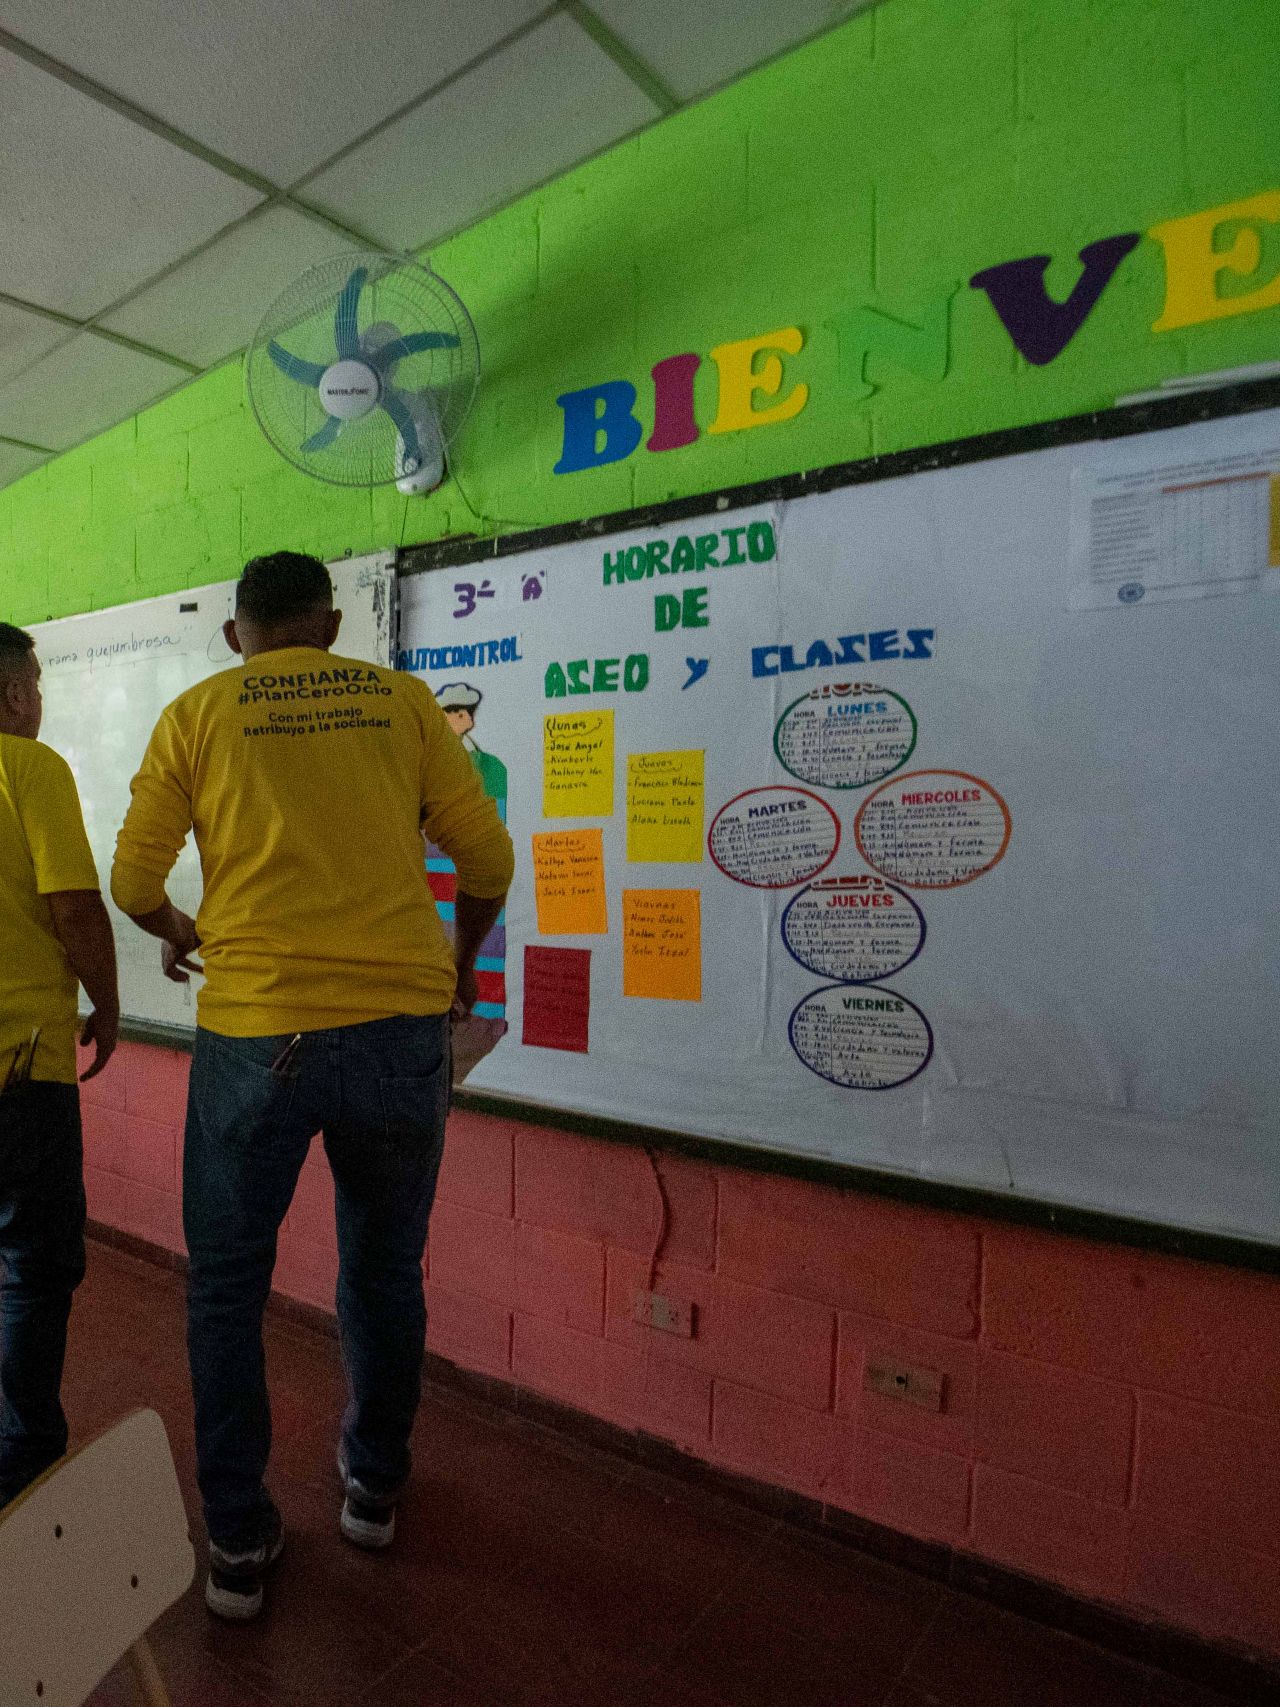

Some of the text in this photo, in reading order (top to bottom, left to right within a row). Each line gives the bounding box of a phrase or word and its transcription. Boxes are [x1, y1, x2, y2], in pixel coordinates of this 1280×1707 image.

[602, 520, 776, 586] HORARIO
[654, 586, 710, 633] DE
[398, 635, 523, 672] AUTOCONTROL
[544, 652, 651, 699] ASEO
[751, 628, 936, 678] CLASES
[241, 668, 382, 691] CONFIANZA
[237, 682, 393, 706] #PlanCeroOcio
[268, 706, 363, 724] Con mi trabajo
[826, 701, 887, 717] LUNES
[243, 717, 391, 738] Retribuyo a la sociedad
[901, 788, 981, 806] MIERCOLES
[747, 799, 808, 819] MARTES
[826, 894, 895, 908] JUEVES
[841, 997, 905, 1013] VIERNES
